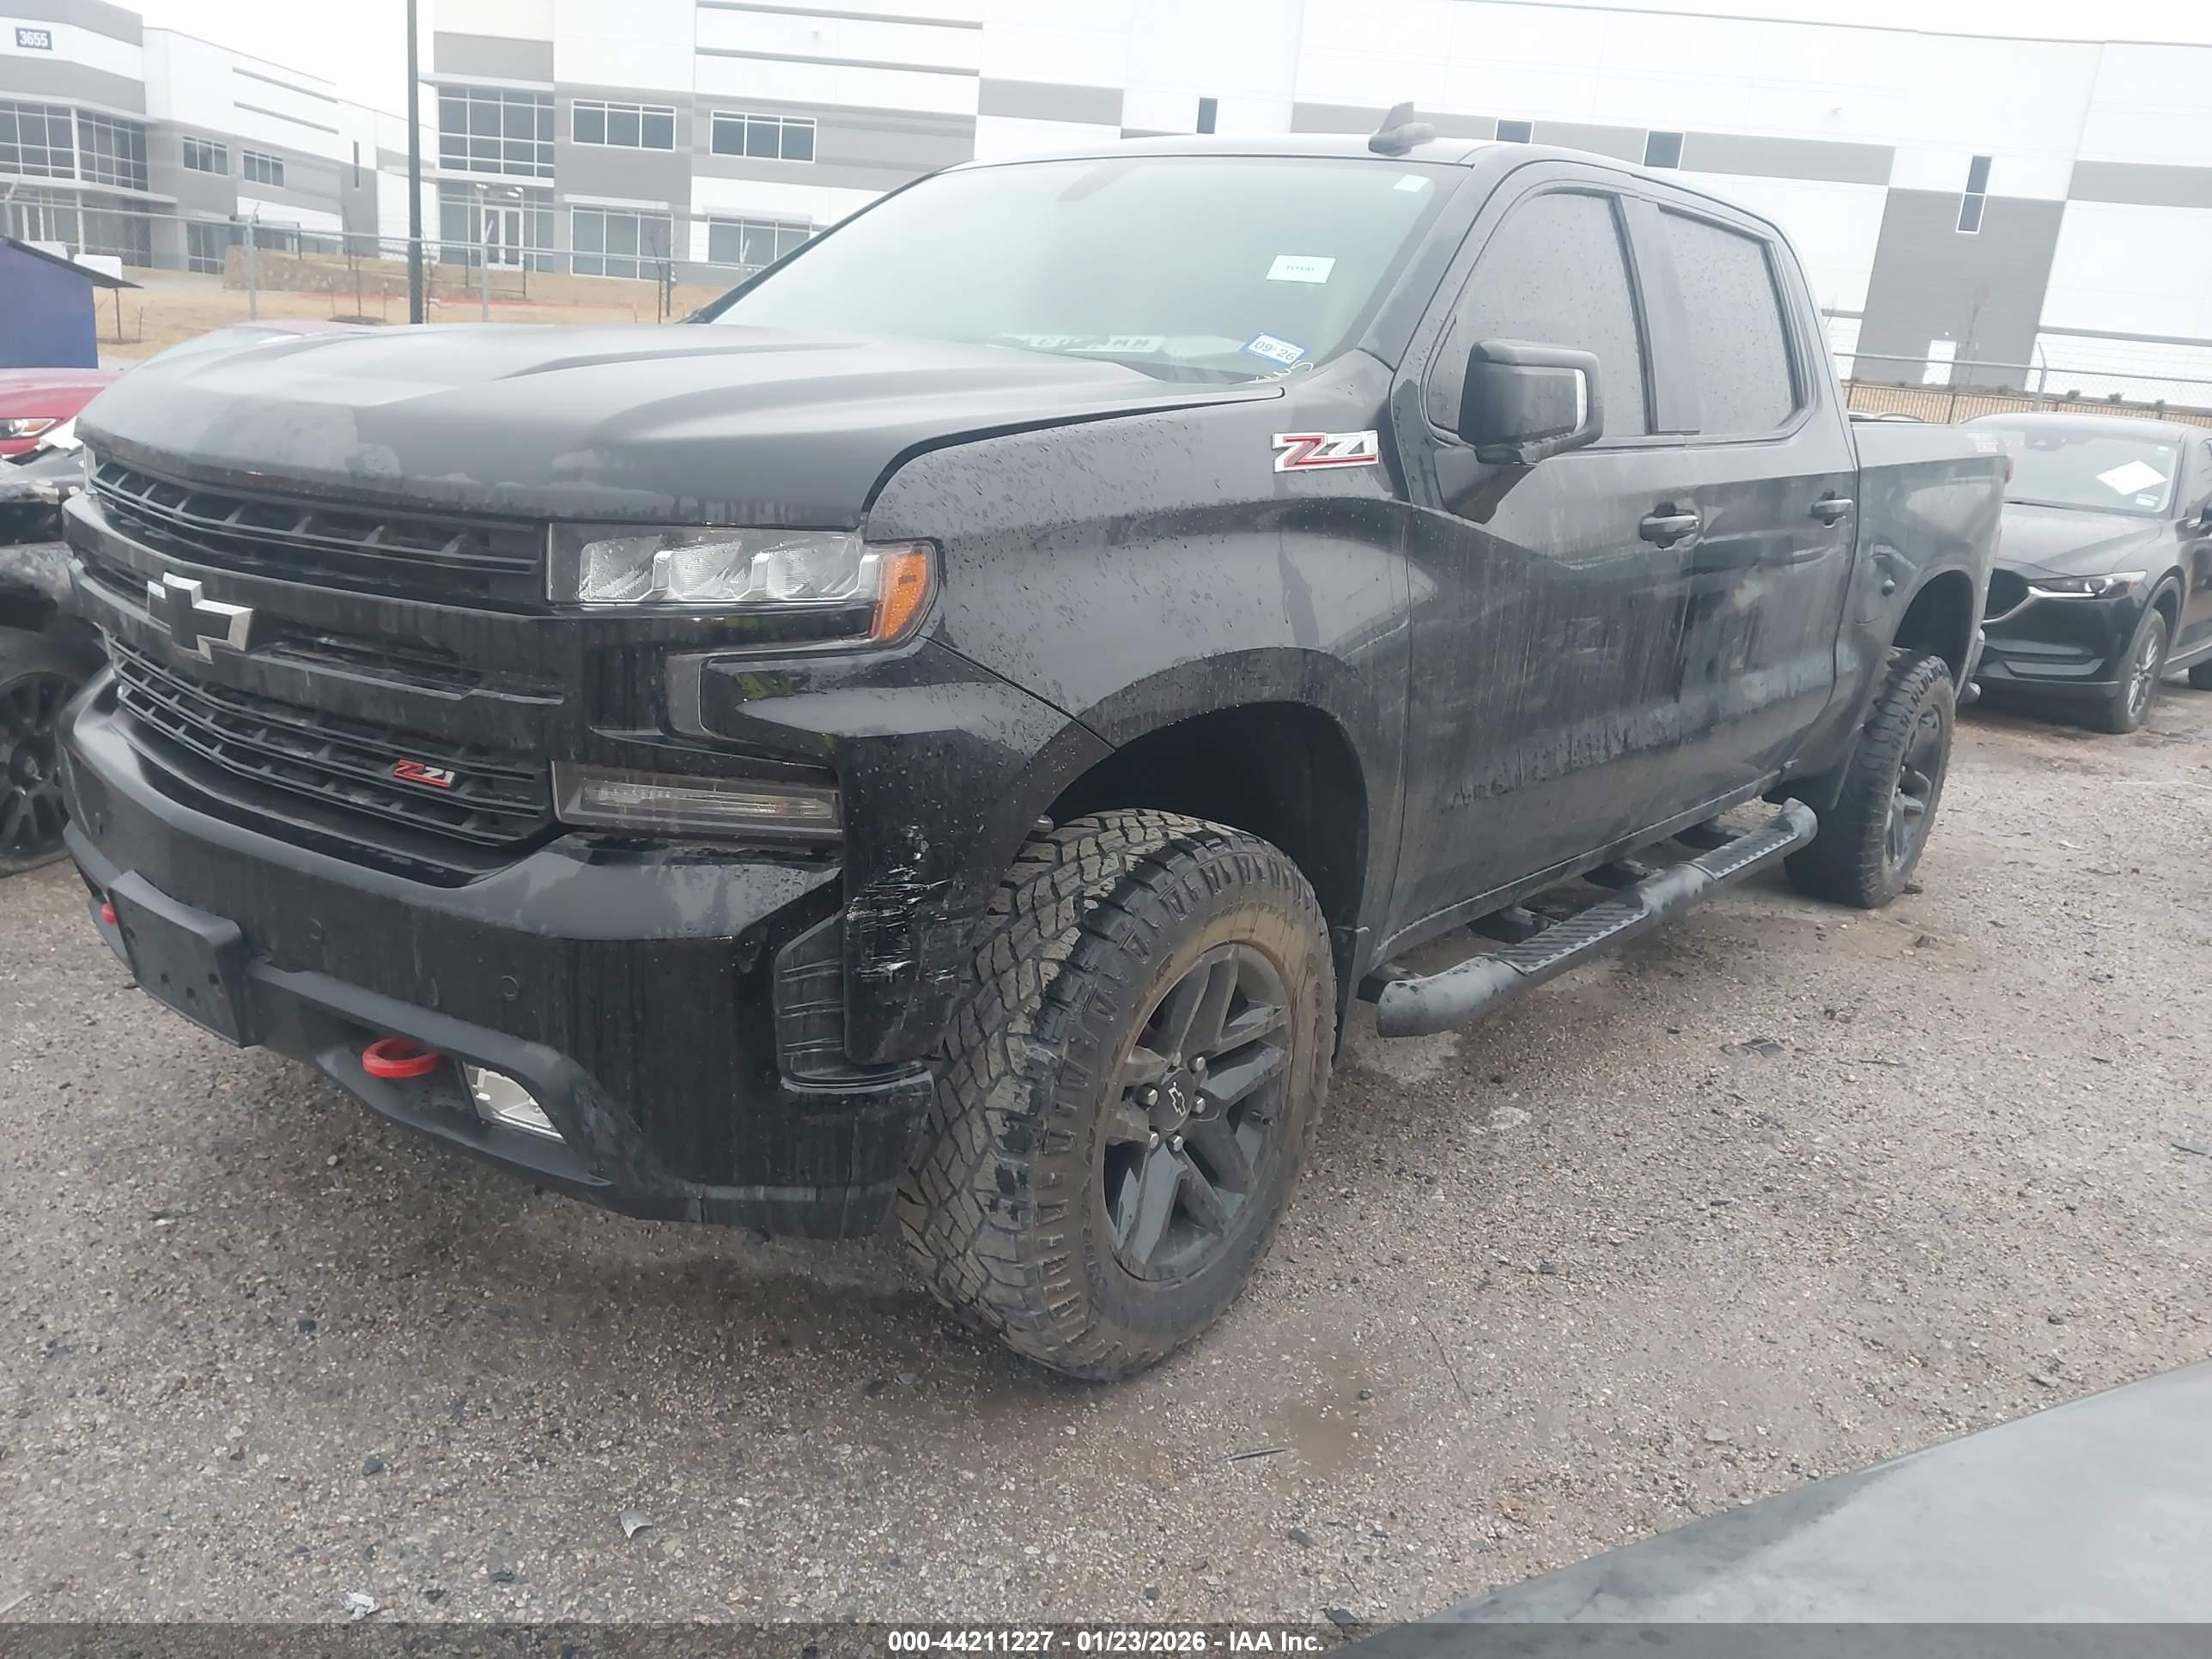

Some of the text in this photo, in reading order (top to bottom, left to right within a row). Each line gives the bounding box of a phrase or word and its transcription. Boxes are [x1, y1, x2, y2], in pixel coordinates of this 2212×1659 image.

[19, 31, 48, 47] 3655
[1255, 341, 1297, 361] 09 26
[1272, 429, 1379, 472] Z71
[393, 759, 455, 788] Z71
